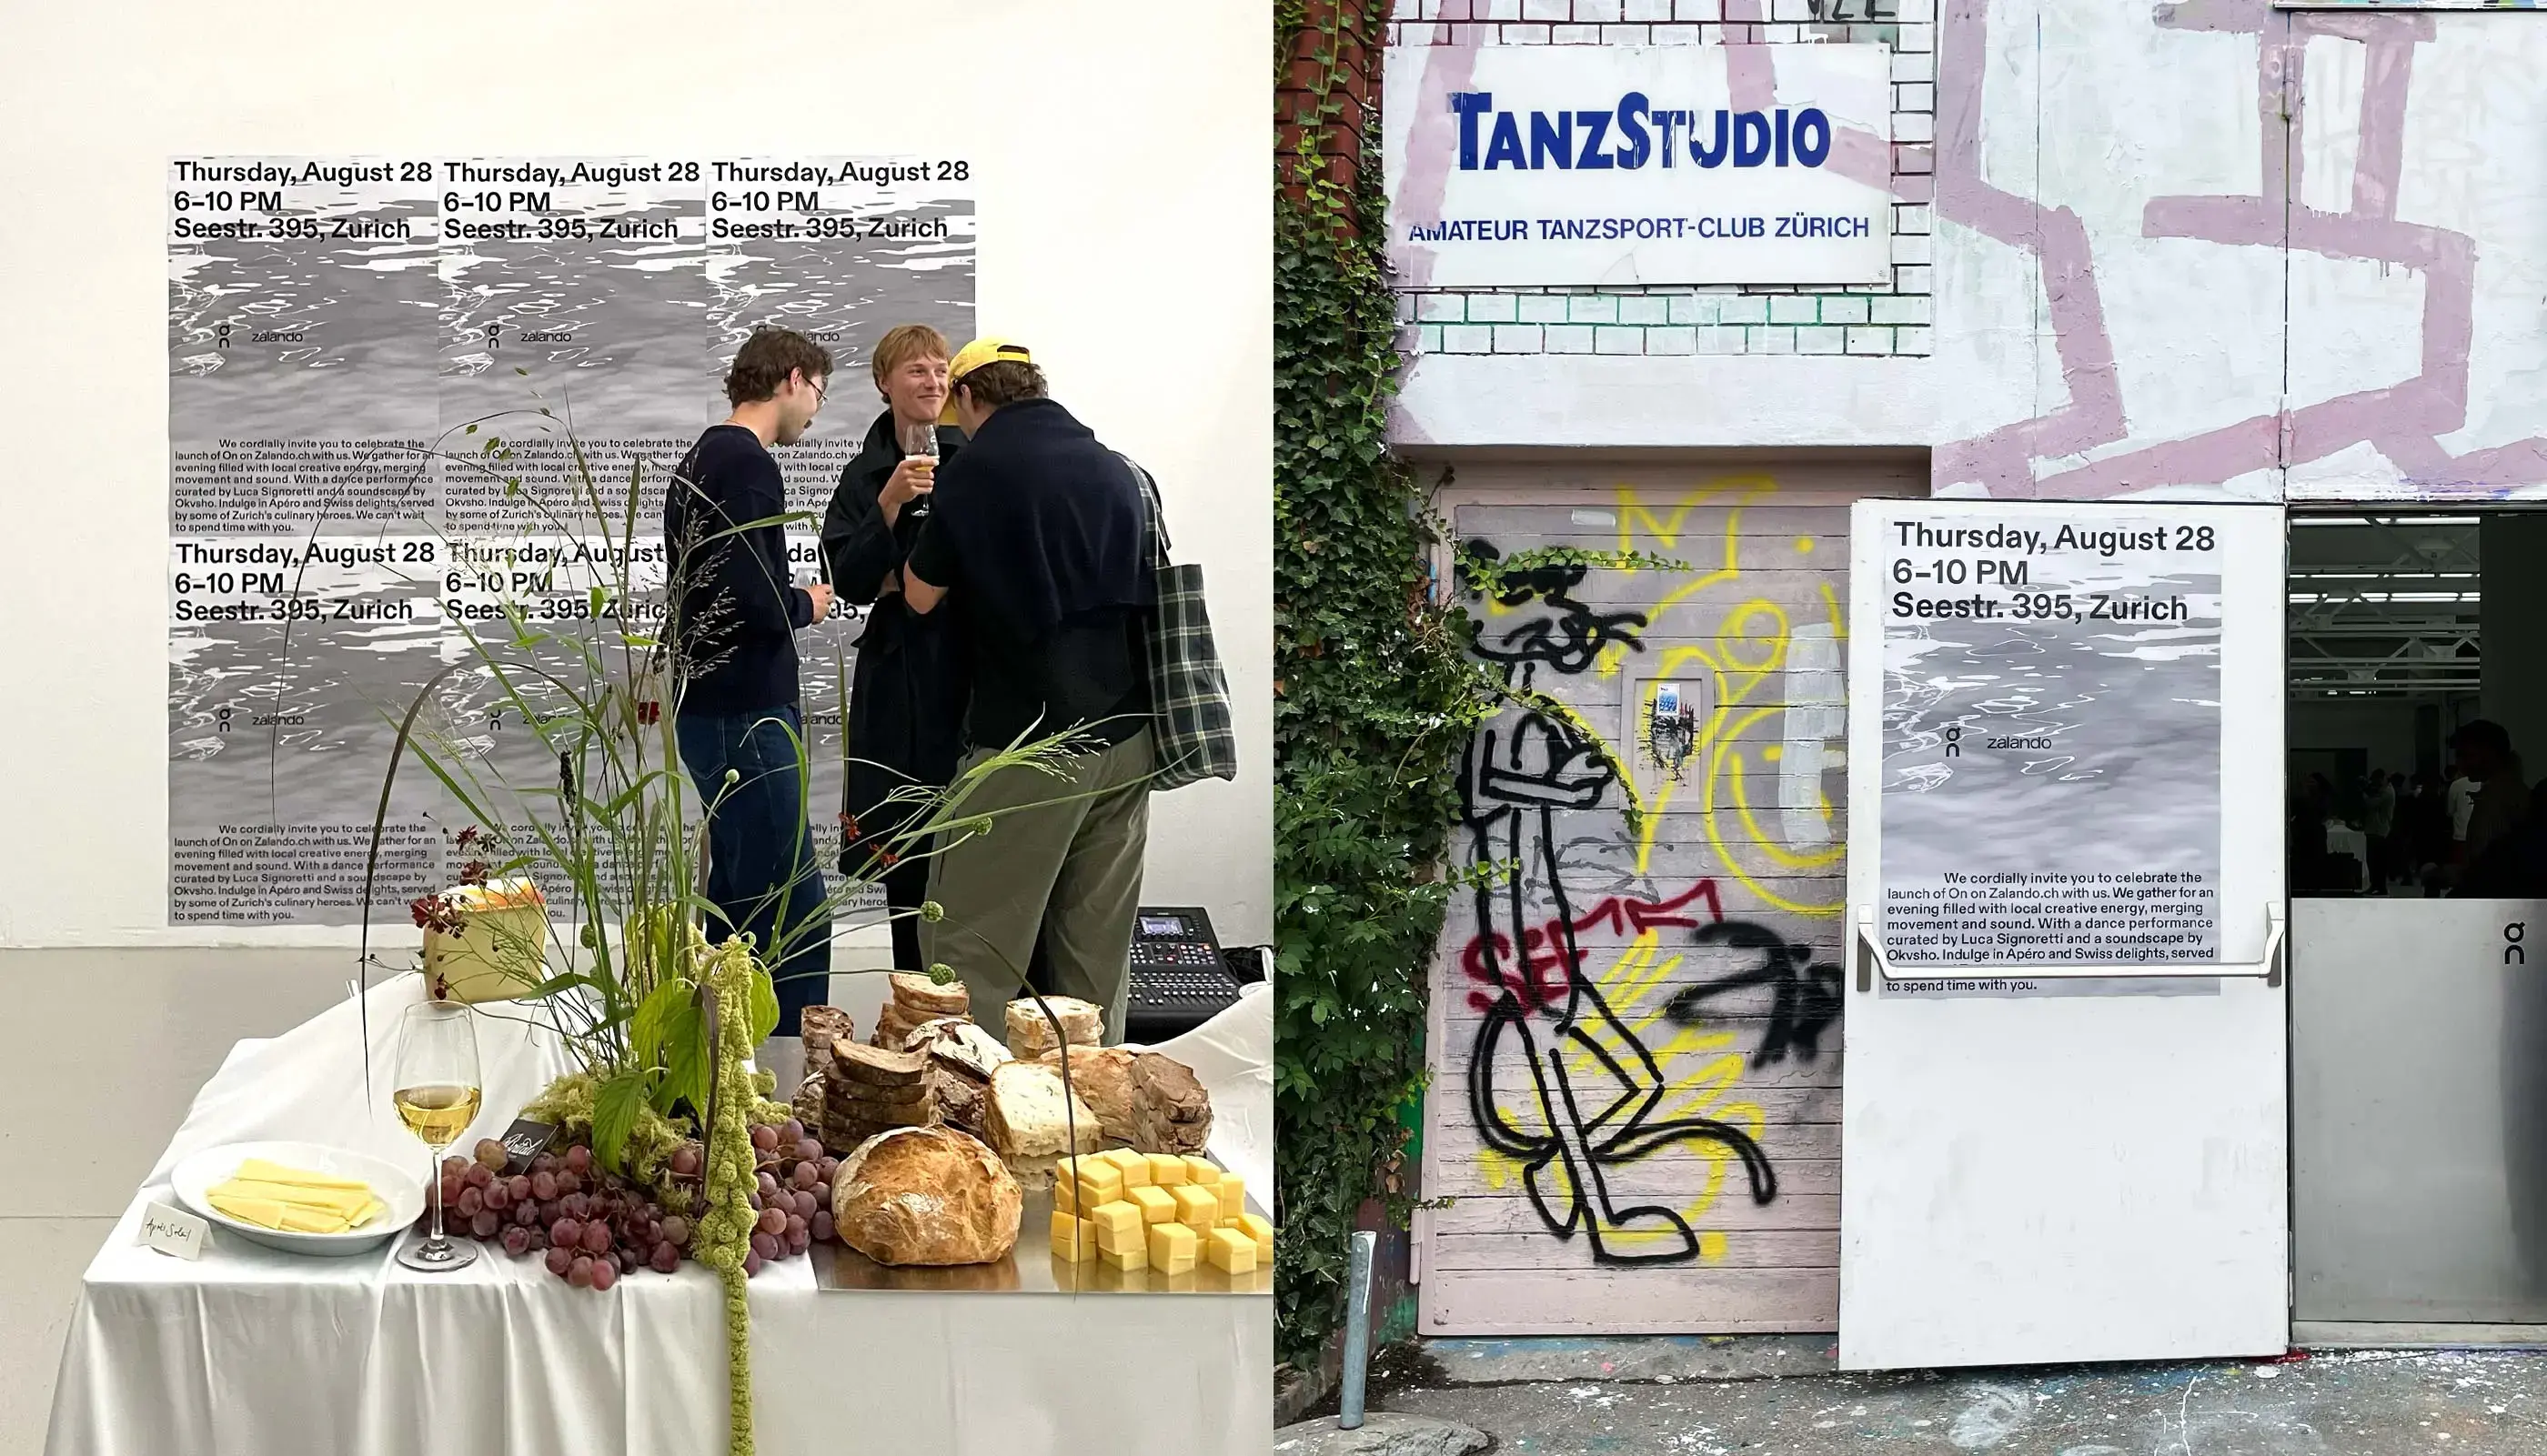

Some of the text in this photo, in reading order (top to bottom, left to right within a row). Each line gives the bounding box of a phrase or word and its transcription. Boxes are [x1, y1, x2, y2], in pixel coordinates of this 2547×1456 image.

[175, 162, 431, 186] Thursday, August 28
[444, 162, 699, 186] Thursday, August 28
[712, 161, 968, 186] Thursday, August 28
[241, 191, 281, 211] PM
[510, 192, 549, 211] PM
[778, 192, 818, 211] PM
[175, 218, 409, 243] Seestr. 395, Zurich
[444, 218, 677, 243] Seestr. 395, Zurich
[712, 218, 946, 242] Seestr. 395, Zurich
[1409, 212, 1869, 241] AMATEUR TANZSPORT-CLUB ZÜRICH
[252, 332, 303, 343] zalando
[521, 332, 571, 343] zalando
[219, 439, 424, 449] We cordially invite you to celebrate the
[175, 511, 187, 522] by
[220, 511, 230, 520] of
[275, 511, 314, 522] culinary
[317, 511, 354, 520] heroes.
[357, 511, 373, 520] We
[175, 523, 293, 533] to spend time with you.
[1894, 522, 2215, 557] Thursday, August 28
[176, 543, 434, 568] Thursday, August 28
[573, 543, 664, 567] August
[512, 572, 552, 592] PM
[1978, 560, 2028, 585] PM
[242, 573, 284, 593] PM
[176, 599, 411, 625] Seestr. 395, Zurich
[602, 599, 667, 619] Zuric
[1893, 592, 2187, 624] Seestr. 395, Zurich
[253, 715, 304, 726] zalando
[1988, 737, 2051, 749] zalando
[175, 849, 341, 860] evening filled with local creative
[1944, 872, 2202, 886] We cordially invite you to celebrate the
[1888, 889, 1930, 899] launch
[1932, 889, 1947, 899] of
[1948, 889, 1968, 899] On
[1988, 888, 2059, 898] Zalando.ch
[2061, 889, 2089, 898] with
[2092, 890, 2110, 899] us.
[2112, 887, 2134, 898] We
[2136, 887, 2178, 900] gather
[2179, 887, 2197, 897] for
[175, 911, 294, 921] to spend time with you.
[1887, 902, 2203, 917] evening filled with local creative energy, merging
[1887, 919, 1958, 929] movement
[1961, 918, 1987, 929] and
[1989, 919, 2035, 929] sound.
[2038, 918, 2070, 929] With
[2085, 919, 2126, 929] dance
[2129, 917, 2213, 930] performance
[1887, 932, 2203, 948] curated by Luca Signoretti and a soundscape by
[1886, 948, 2214, 962] Okvsho. Indulge in Apéro and Swiss delights, served
[1885, 979, 2038, 994] to spend time with you.
